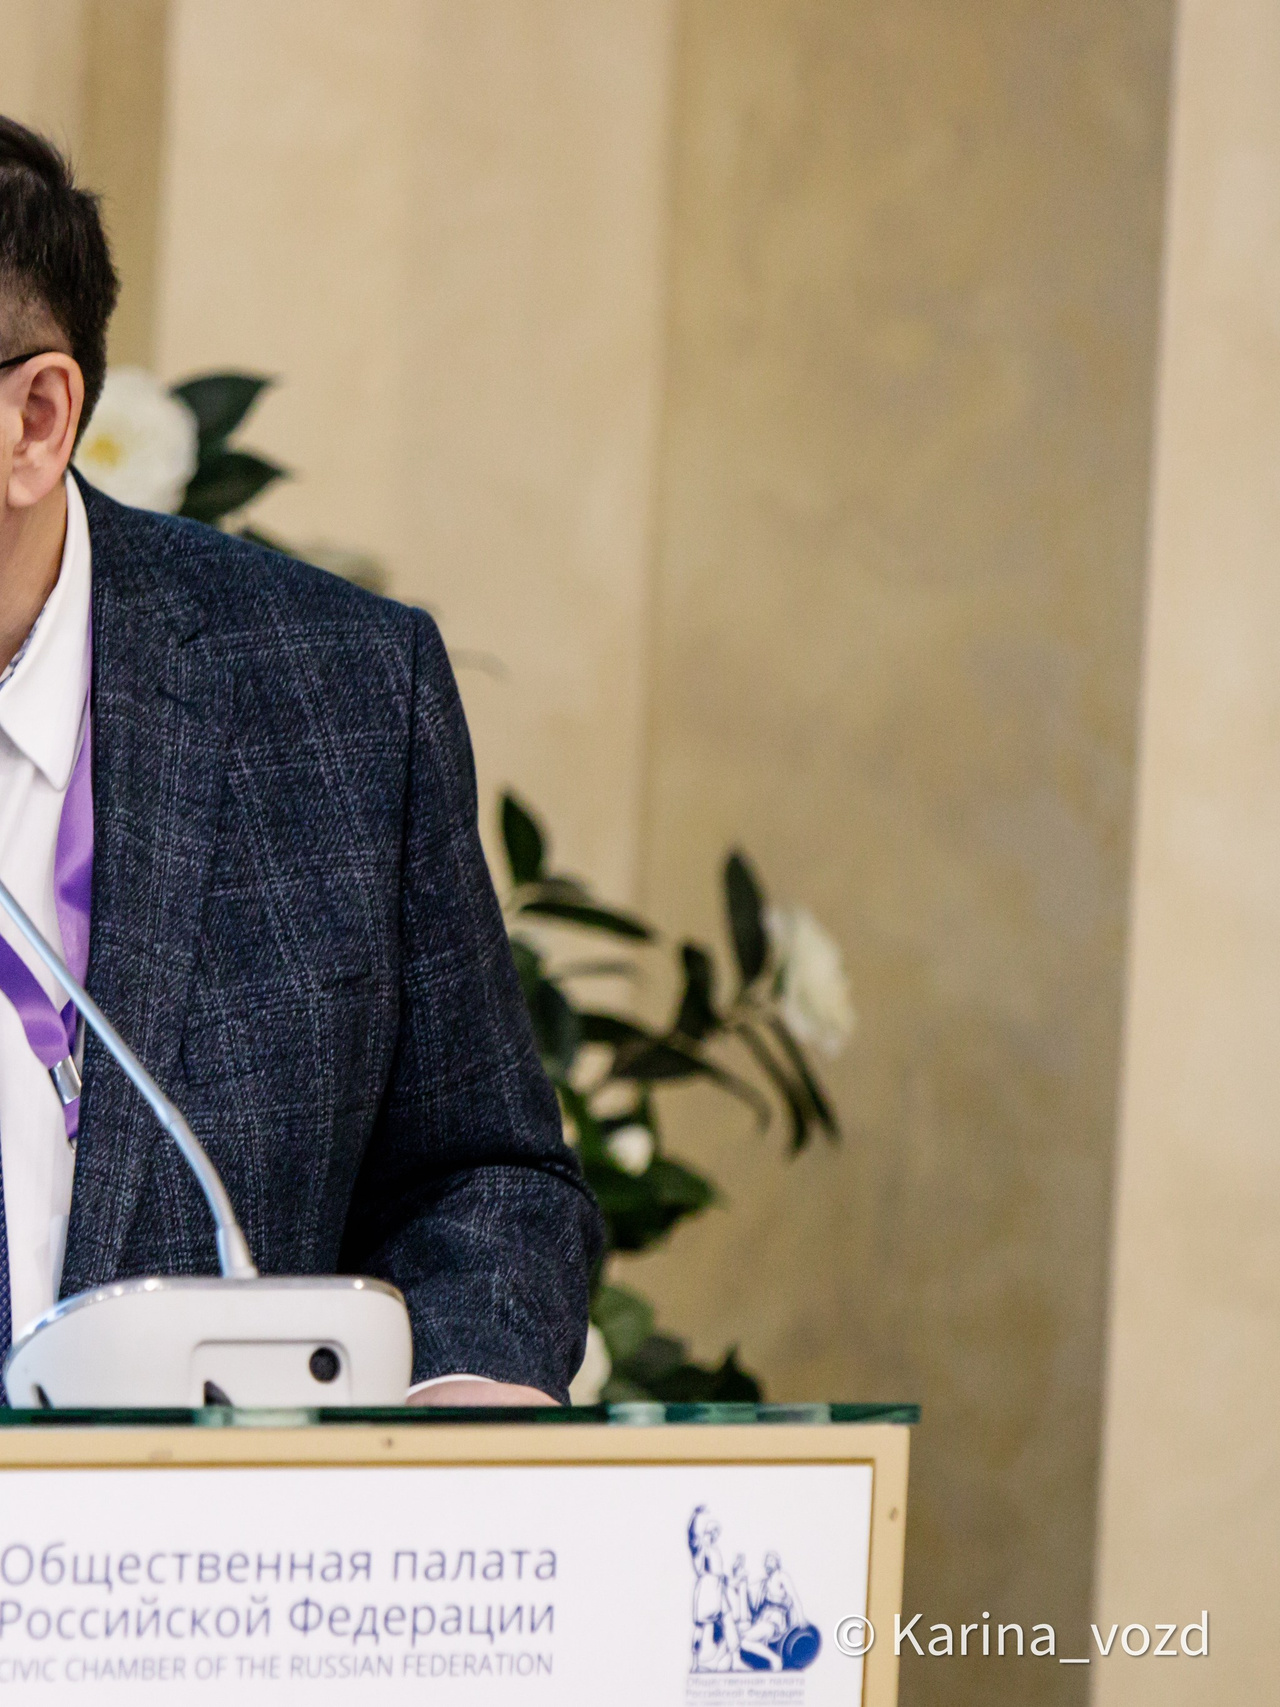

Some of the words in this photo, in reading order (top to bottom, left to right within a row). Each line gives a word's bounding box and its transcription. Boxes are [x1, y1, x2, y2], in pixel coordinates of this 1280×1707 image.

[0, 1542, 372, 1590] Общественная
[393, 1548, 558, 1582] палата
[288, 1596, 555, 1646] Федерации
[65, 1656, 187, 1681] CHAMBER
[194, 1655, 227, 1680] OF
[236, 1655, 281, 1679] THE
[290, 1654, 394, 1678] RUSSIAN
[402, 1652, 553, 1677] FEDERATION
